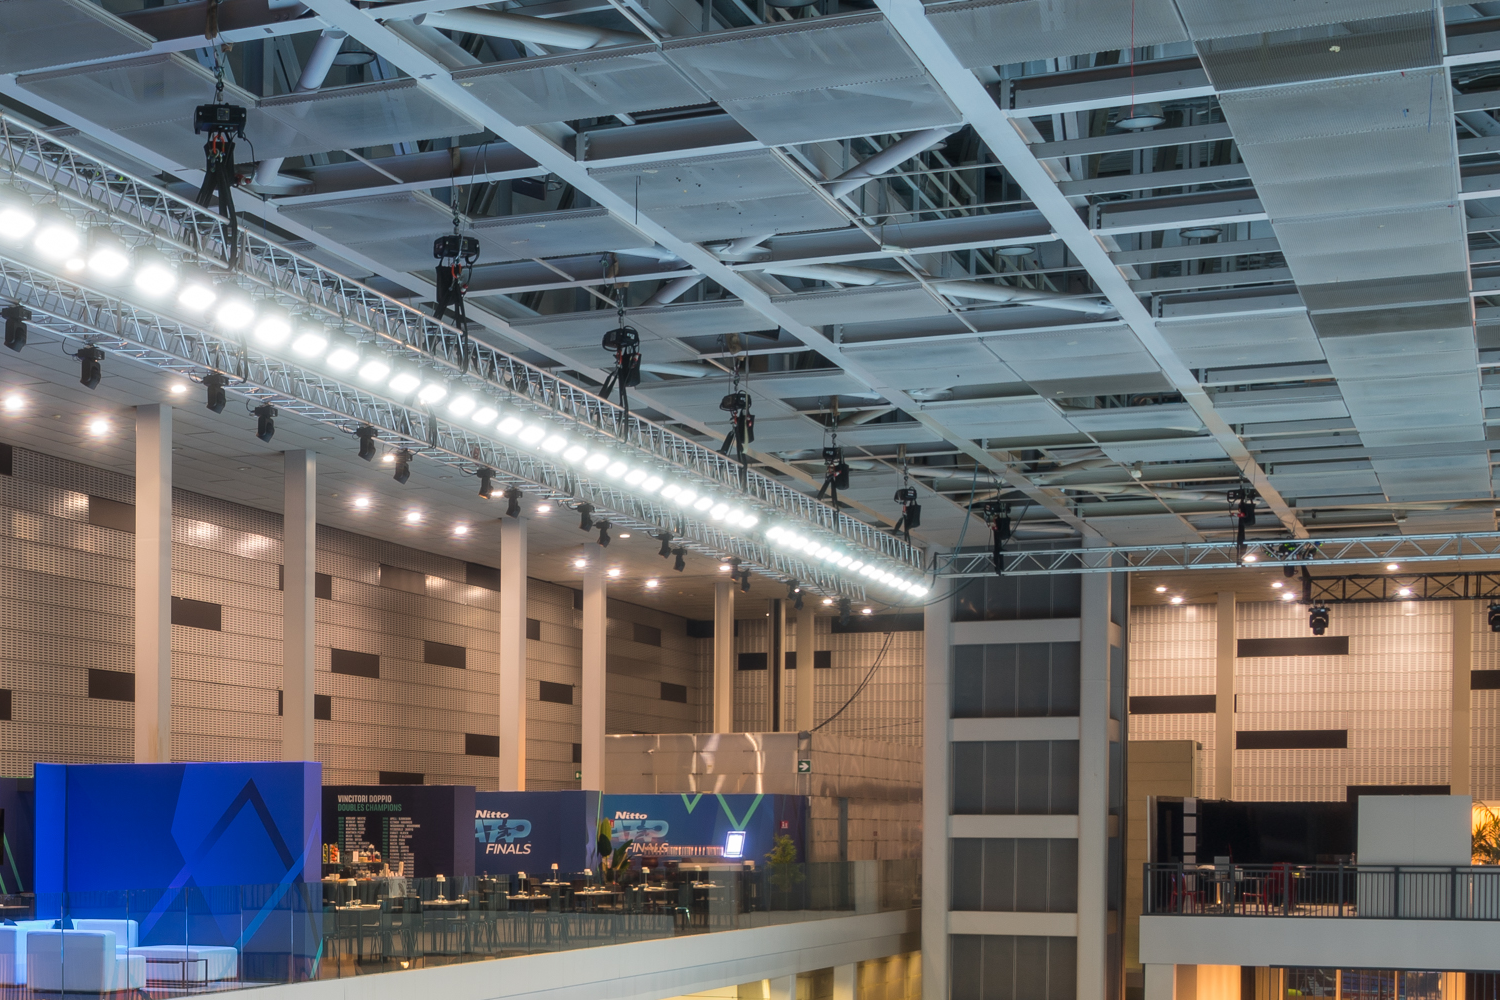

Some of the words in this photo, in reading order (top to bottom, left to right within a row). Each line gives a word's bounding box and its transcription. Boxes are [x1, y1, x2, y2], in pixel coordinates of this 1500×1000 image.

[338, 804, 364, 812] DOUBLES
[366, 804, 402, 812] CHAMPIONS
[475, 810, 509, 818] Nitto
[615, 811, 648, 819] Nitto
[475, 819, 532, 843] ATP
[611, 820, 669, 842] ATP
[486, 844, 532, 854] FINALS
[625, 843, 669, 853] FINALS
